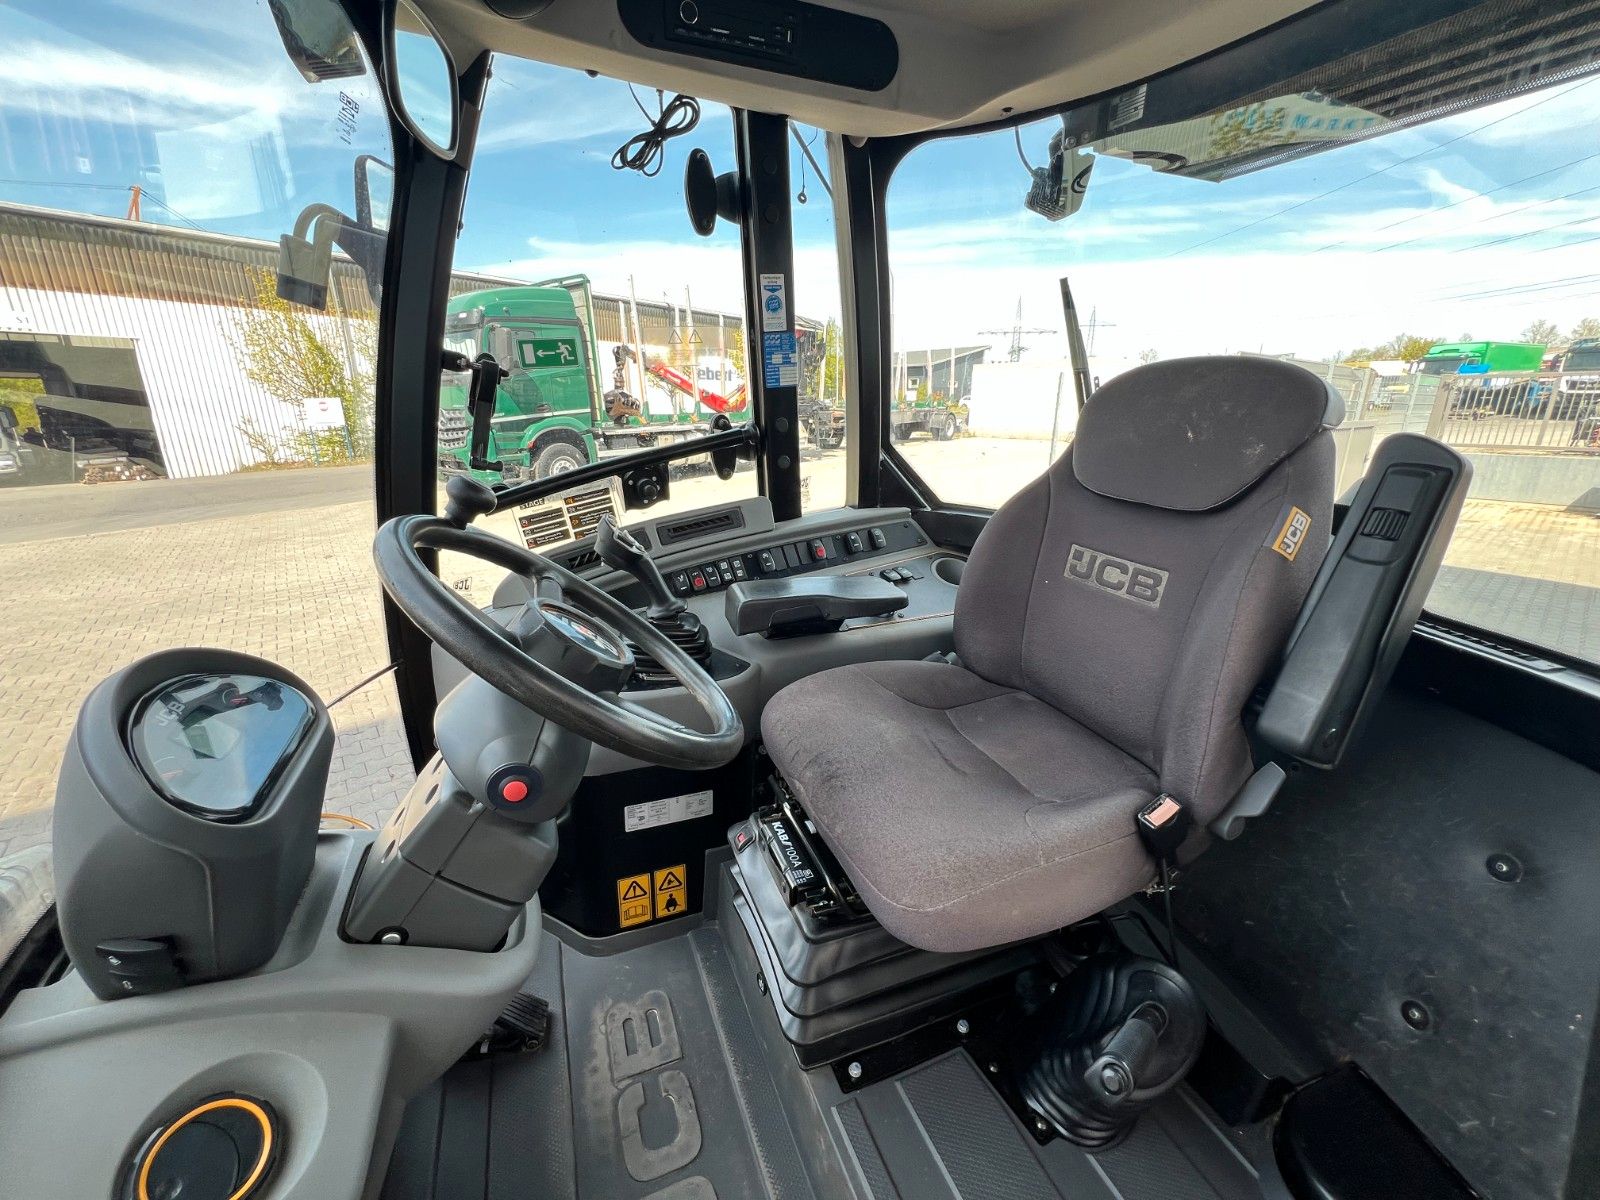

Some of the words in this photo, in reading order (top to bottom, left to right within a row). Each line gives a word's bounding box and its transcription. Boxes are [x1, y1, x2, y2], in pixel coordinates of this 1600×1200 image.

[1281, 513, 1308, 554] JCB
[1067, 547, 1165, 604] JCB
[155, 701, 186, 727] JCB
